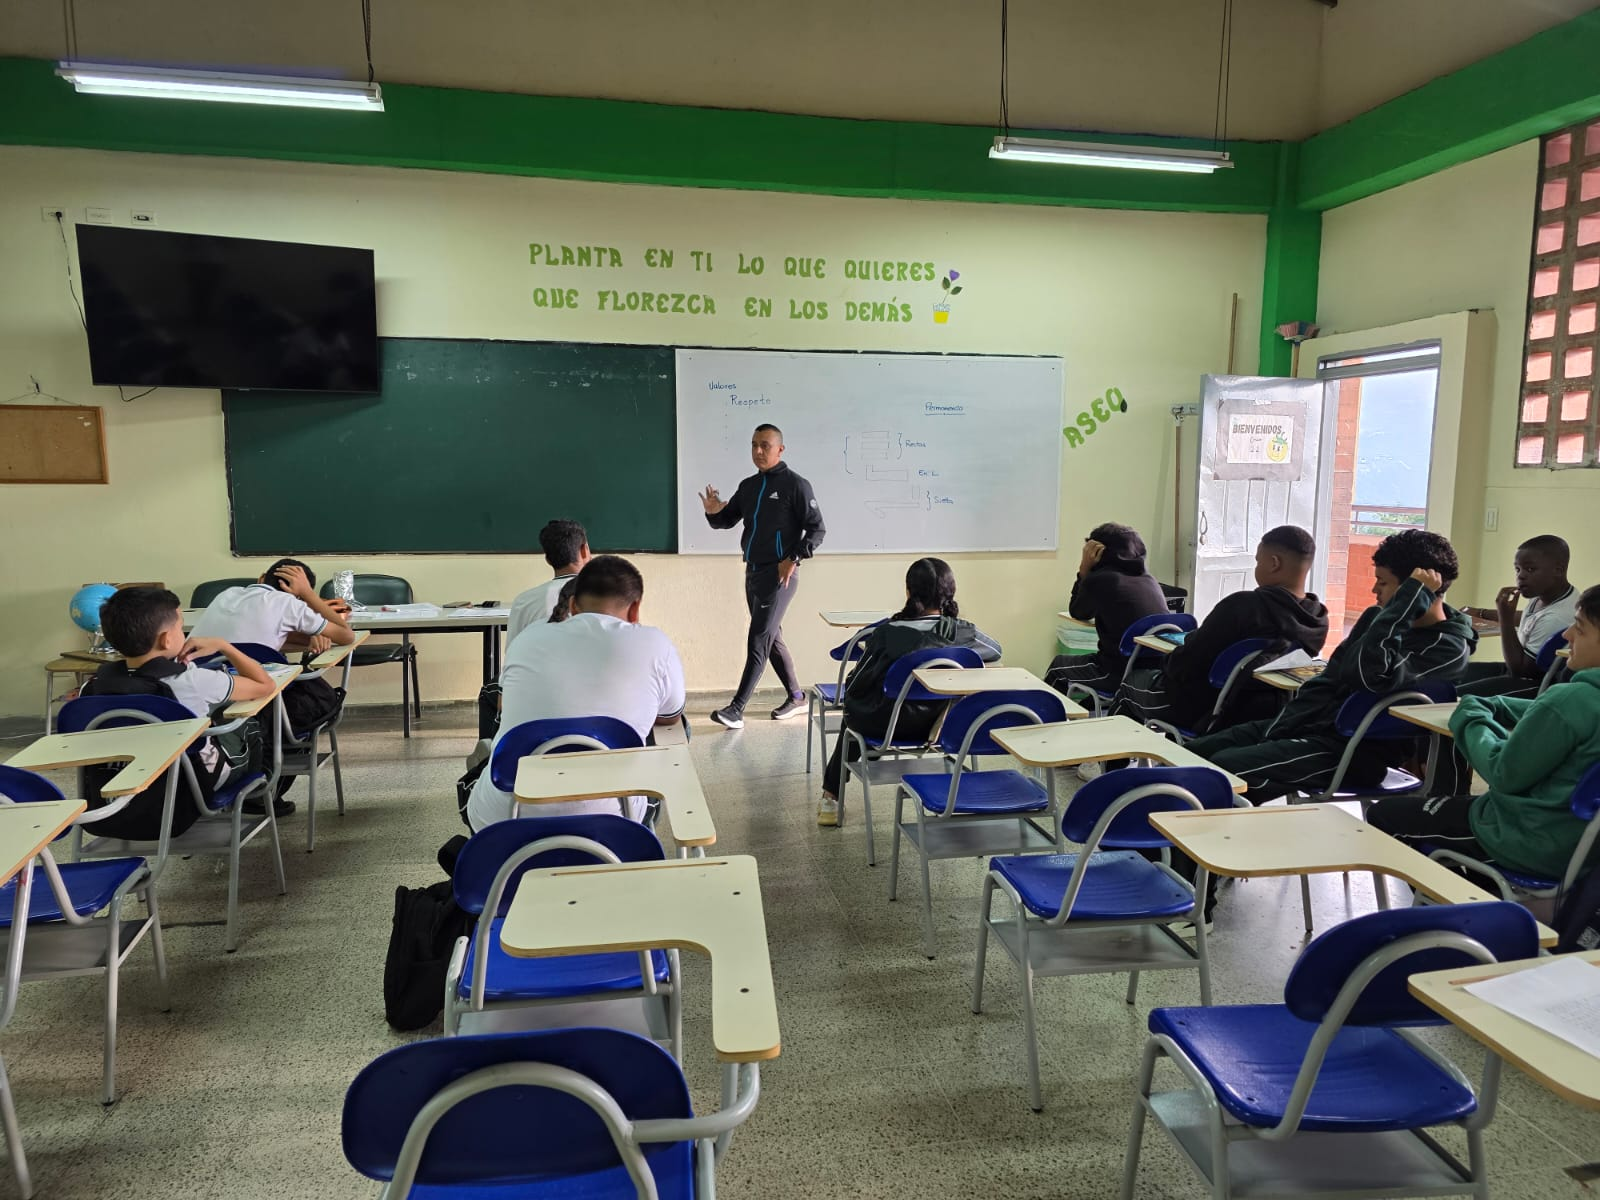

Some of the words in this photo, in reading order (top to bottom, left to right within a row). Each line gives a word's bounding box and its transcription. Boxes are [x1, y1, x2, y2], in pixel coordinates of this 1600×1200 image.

[529, 243, 623, 267] PLANTA
[644, 248, 674, 268] EN
[690, 250, 713, 272] TI
[737, 253, 765, 275] LO
[784, 256, 826, 279] QUE
[844, 259, 936, 282] QUIERES
[533, 287, 579, 309] QUE
[597, 290, 717, 314] FLOREZCA
[744, 296, 772, 318] EN
[789, 298, 829, 320] LOS
[845, 296, 913, 322] DEMÁS
[1063, 387, 1124, 448] ASEO
[1232, 424, 1283, 435] BIENVENIDOS
